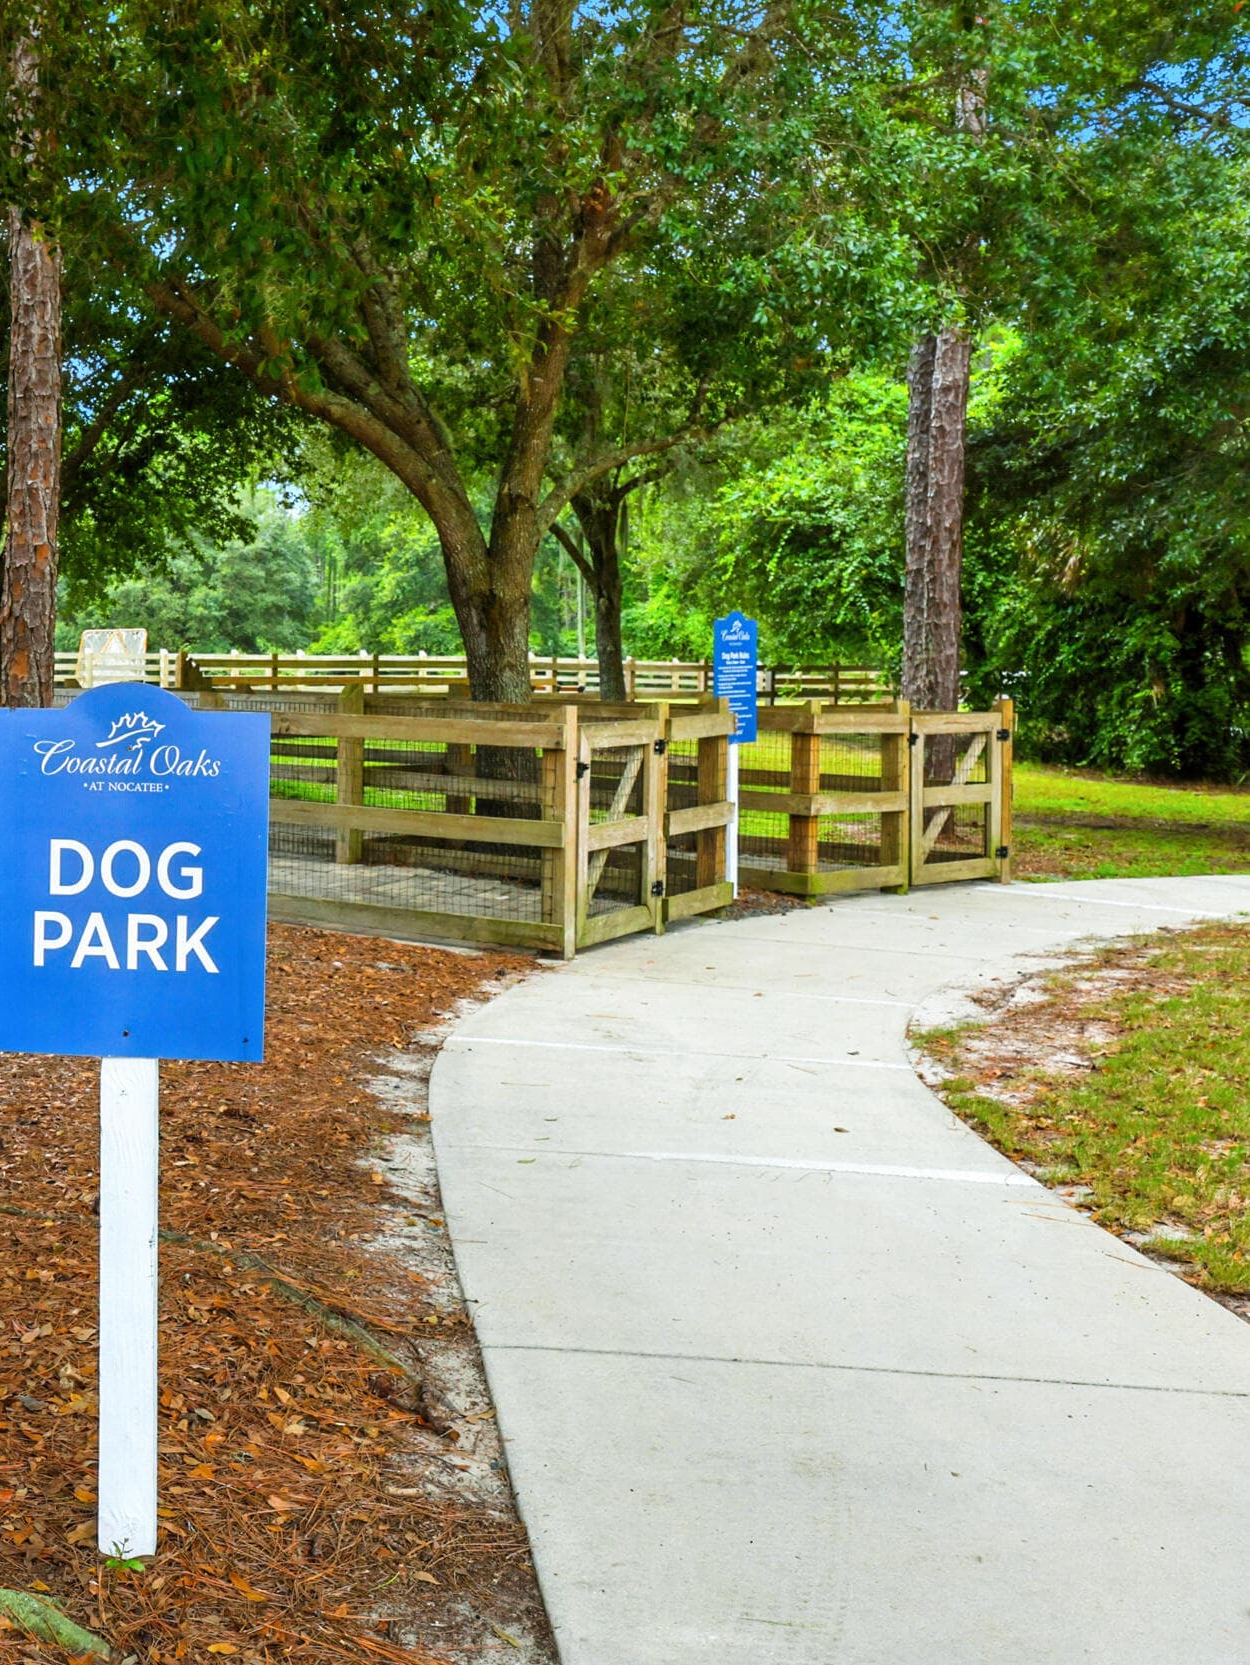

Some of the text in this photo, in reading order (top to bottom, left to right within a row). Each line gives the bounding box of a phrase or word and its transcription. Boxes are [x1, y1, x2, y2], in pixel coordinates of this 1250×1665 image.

[721, 652, 730, 660] Dog
[33, 739, 222, 778] Coastal Oaks
[89, 781, 163, 793] AT NOCATEE
[49, 838, 203, 900] DOG
[33, 910, 220, 974] PARK
